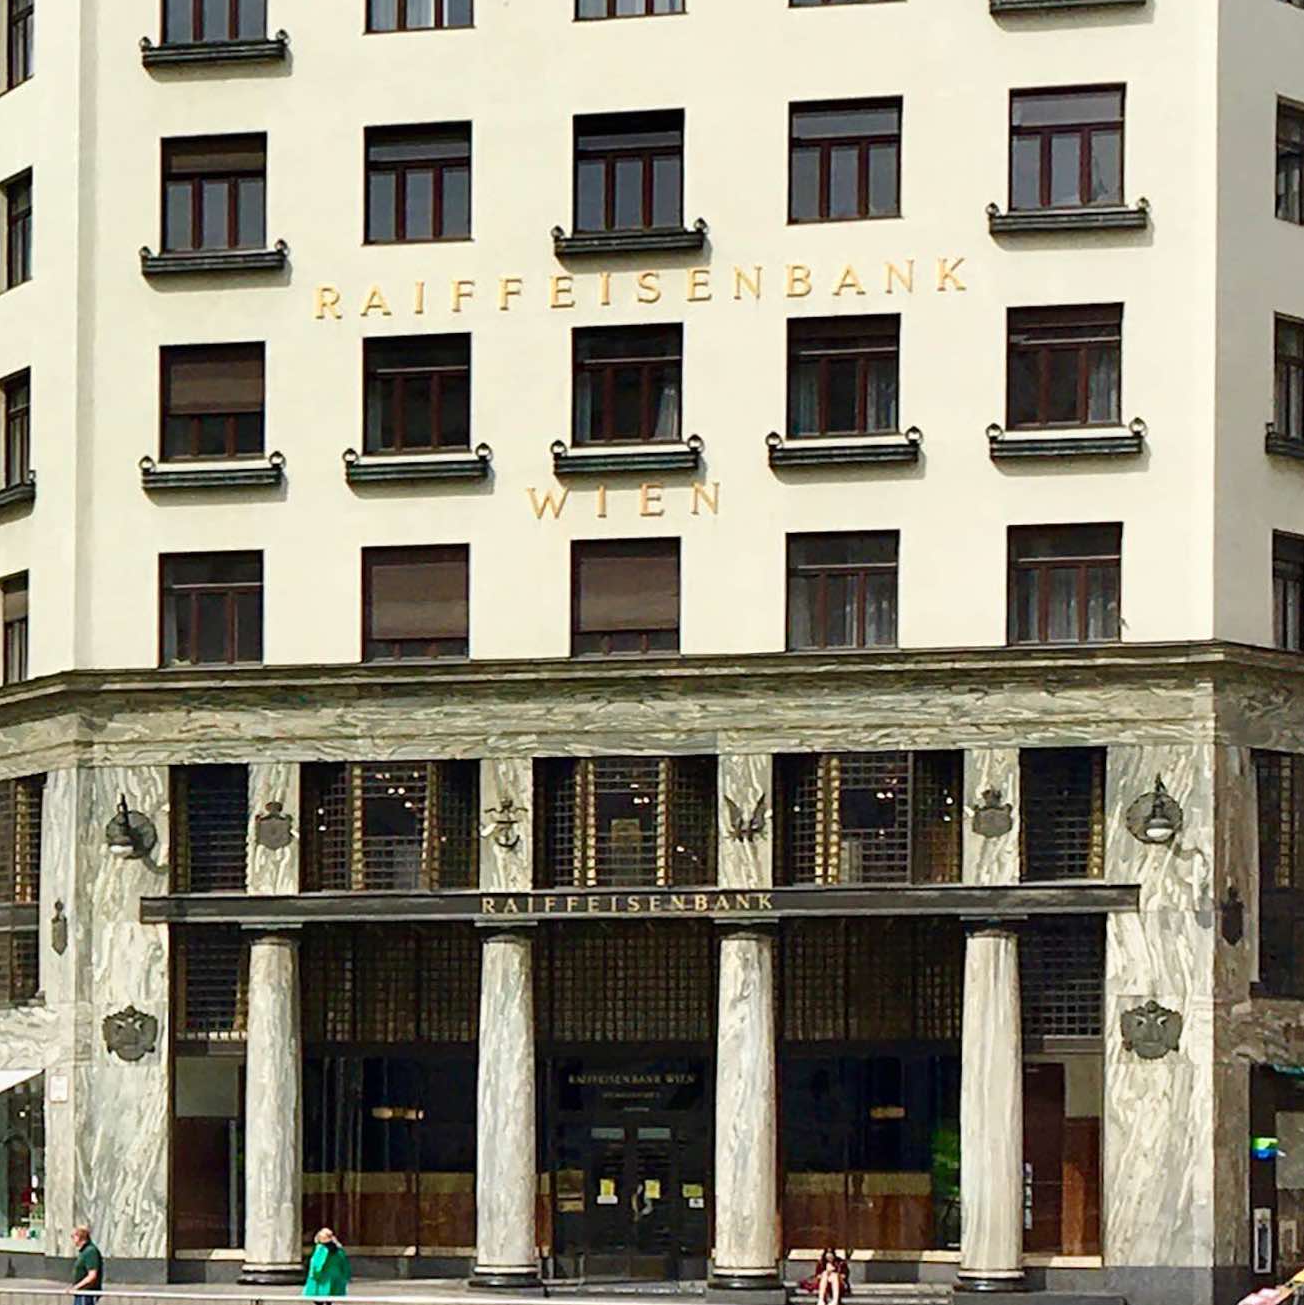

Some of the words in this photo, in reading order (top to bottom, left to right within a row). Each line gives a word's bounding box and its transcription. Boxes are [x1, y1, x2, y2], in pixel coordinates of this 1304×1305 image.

[314, 257, 966, 319] RAIFFEISENBANK
[527, 481, 721, 519] WIEN
[481, 893, 773, 914] RAIFFEISENBANK
